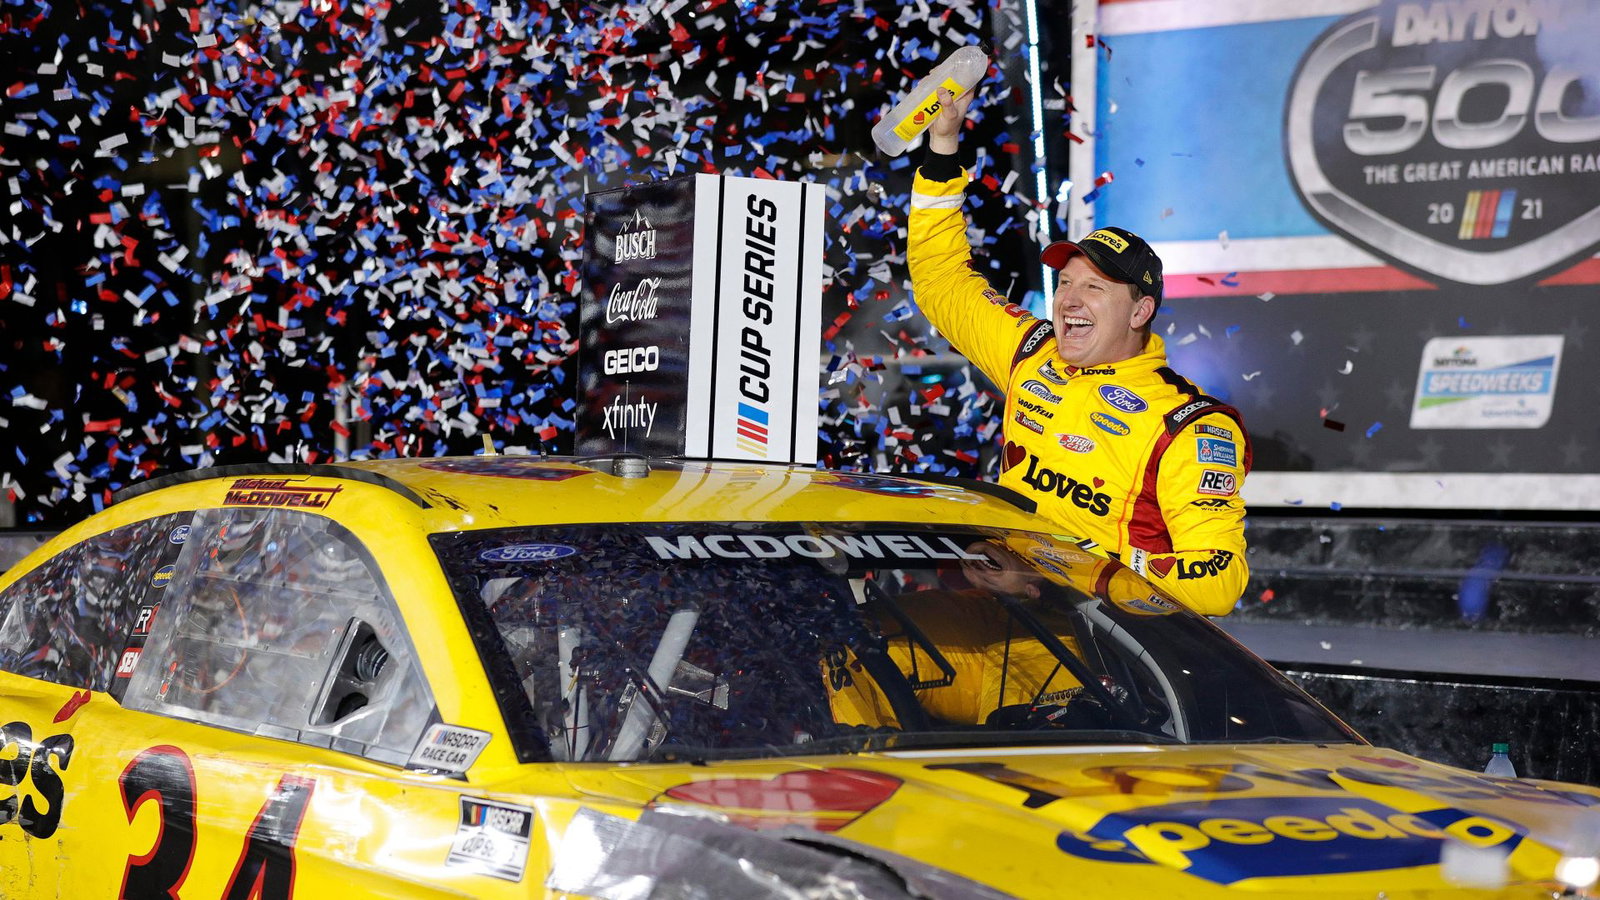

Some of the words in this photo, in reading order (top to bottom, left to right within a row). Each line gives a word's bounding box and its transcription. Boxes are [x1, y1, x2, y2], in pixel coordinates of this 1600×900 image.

[1343, 58, 1600, 155] 500
[1363, 165, 1398, 184] THE
[1403, 163, 1462, 183] GREAT
[1467, 155, 1564, 179] AMERICAN
[1427, 203, 1454, 224] 20
[1521, 199, 1543, 219] 21
[614, 229, 657, 265] BUSCH
[742, 193, 777, 325] SERIES
[606, 277, 662, 324] Coca-Cola
[604, 345, 659, 376] GEICO
[738, 326, 772, 404] CUP
[1428, 372, 1544, 393] SPEEDWEEKS
[1107, 388, 1137, 411] Ford
[602, 394, 658, 440] xfinity
[1092, 412, 1129, 435] speedco
[1207, 425, 1232, 440] NASCAR
[500, 544, 558, 560] Ford
[645, 535, 990, 561] MCDOWELL
[440, 731, 480, 750] NASCAR
[421, 747, 443, 761] RACE
[445, 752, 467, 765] CAR
